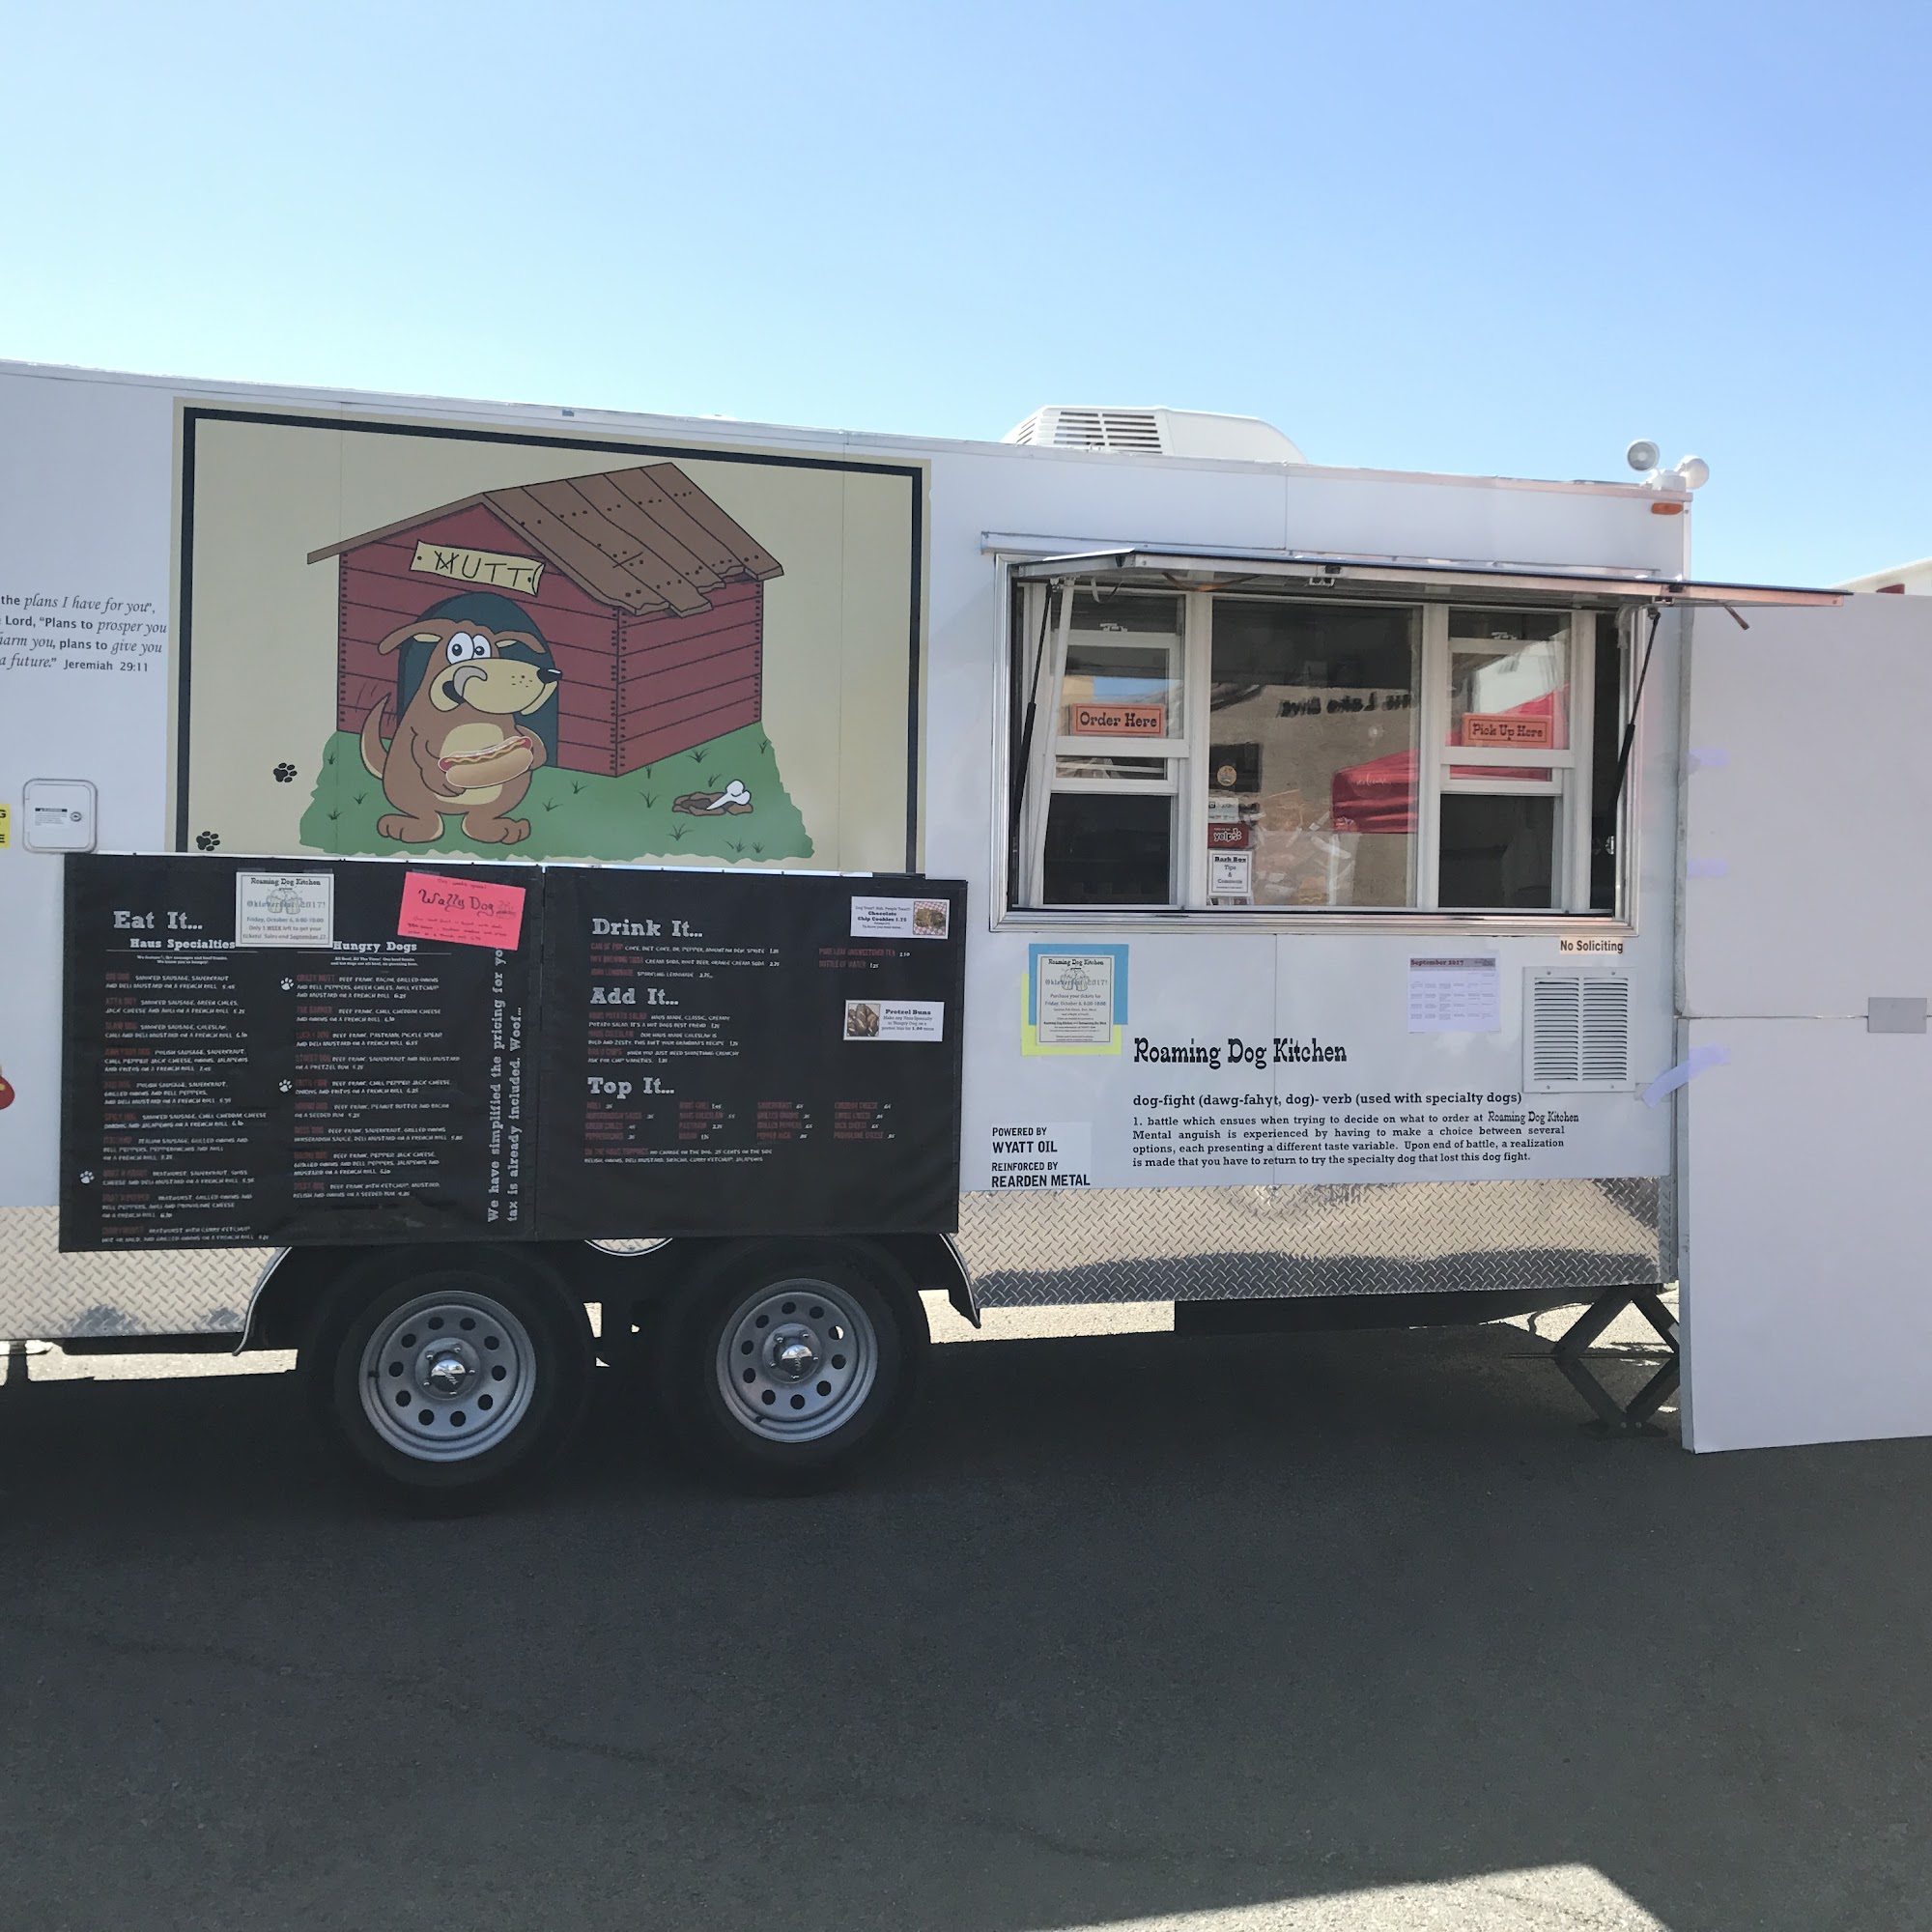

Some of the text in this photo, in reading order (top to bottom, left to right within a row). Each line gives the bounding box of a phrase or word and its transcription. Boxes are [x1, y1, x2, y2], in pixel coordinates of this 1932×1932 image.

[435, 551, 533, 586] MUTT
[1, 595, 20, 605] the
[24, 593, 58, 610] plans
[62, 597, 69, 608] I
[72, 596, 100, 610] have
[100, 598, 124, 614] for
[6, 615, 36, 628] Lord,
[81, 620, 93, 629] to
[97, 620, 143, 636] prosper
[144, 623, 166, 636] you
[29, 638, 162, 656] you, plans to give you
[64, 659, 112, 669] Jeremiah
[120, 662, 148, 671] 29:11
[1080, 711, 1156, 727] Order Here
[1473, 724, 1543, 740] Pick Up Here
[1213, 832, 1233, 841] yelp
[114, 911, 202, 929] Eat It...
[592, 919, 702, 937] Drink It...
[130, 939, 235, 951] Haus Specialties
[333, 941, 417, 952] Hungry Dogs
[1560, 940, 1623, 953] No Soliciting
[590, 987, 678, 1005] Add It...
[1134, 1037, 1347, 1069] Roaming Dog Kitchen
[488, 948, 506, 1222] We have simplified the pricing for yo
[587, 1077, 674, 1099] Top It...
[1133, 1093, 1521, 1108] dog-fight (dawg-fahyt, dog)- verb (used with specialty dogs)
[507, 1008, 522, 1221] tax is already included. Woof...
[1148, 1117, 1179, 1125] battle
[1261, 1116, 1289, 1124] when
[1293, 1117, 1325, 1125] trying
[1345, 1115, 1378, 1123] decide
[1400, 1114, 1425, 1122] what
[1489, 1111, 1525, 1124] Roaming
[1528, 1111, 1545, 1124] Dog
[1548, 1111, 1578, 1122] Kitchen
[992, 1127, 1034, 1136] POWERED
[1133, 1130, 1171, 1139] Mental
[1179, 1130, 1220, 1141] anguish
[1228, 1130, 1236, 1139] is
[1243, 1129, 1308, 1140] experienced
[1315, 1128, 1327, 1139] by
[1334, 1128, 1371, 1139] having
[993, 1141, 1057, 1153] WYATT OIL
[1133, 1145, 1176, 1154] options,
[1179, 1144, 1205, 1152] each
[1208, 1143, 1264, 1153] presenting
[1277, 1143, 1321, 1151] different
[1352, 1141, 1399, 1151] variable.
[1405, 1141, 1430, 1151] Upon
[1454, 1140, 1463, 1149] of
[1466, 1140, 1498, 1150] battle,
[992, 1162, 1044, 1171] REINFORCED
[1179, 1157, 1199, 1166] that
[1202, 1158, 1220, 1168] you
[1312, 1156, 1326, 1166] try
[1348, 1154, 1395, 1165] specialty
[1398, 1154, 1415, 1164] dog
[1483, 1153, 1501, 1163] dog
[1504, 1152, 1530, 1161] fight.
[992, 1175, 1091, 1187] REARDEN METAL
